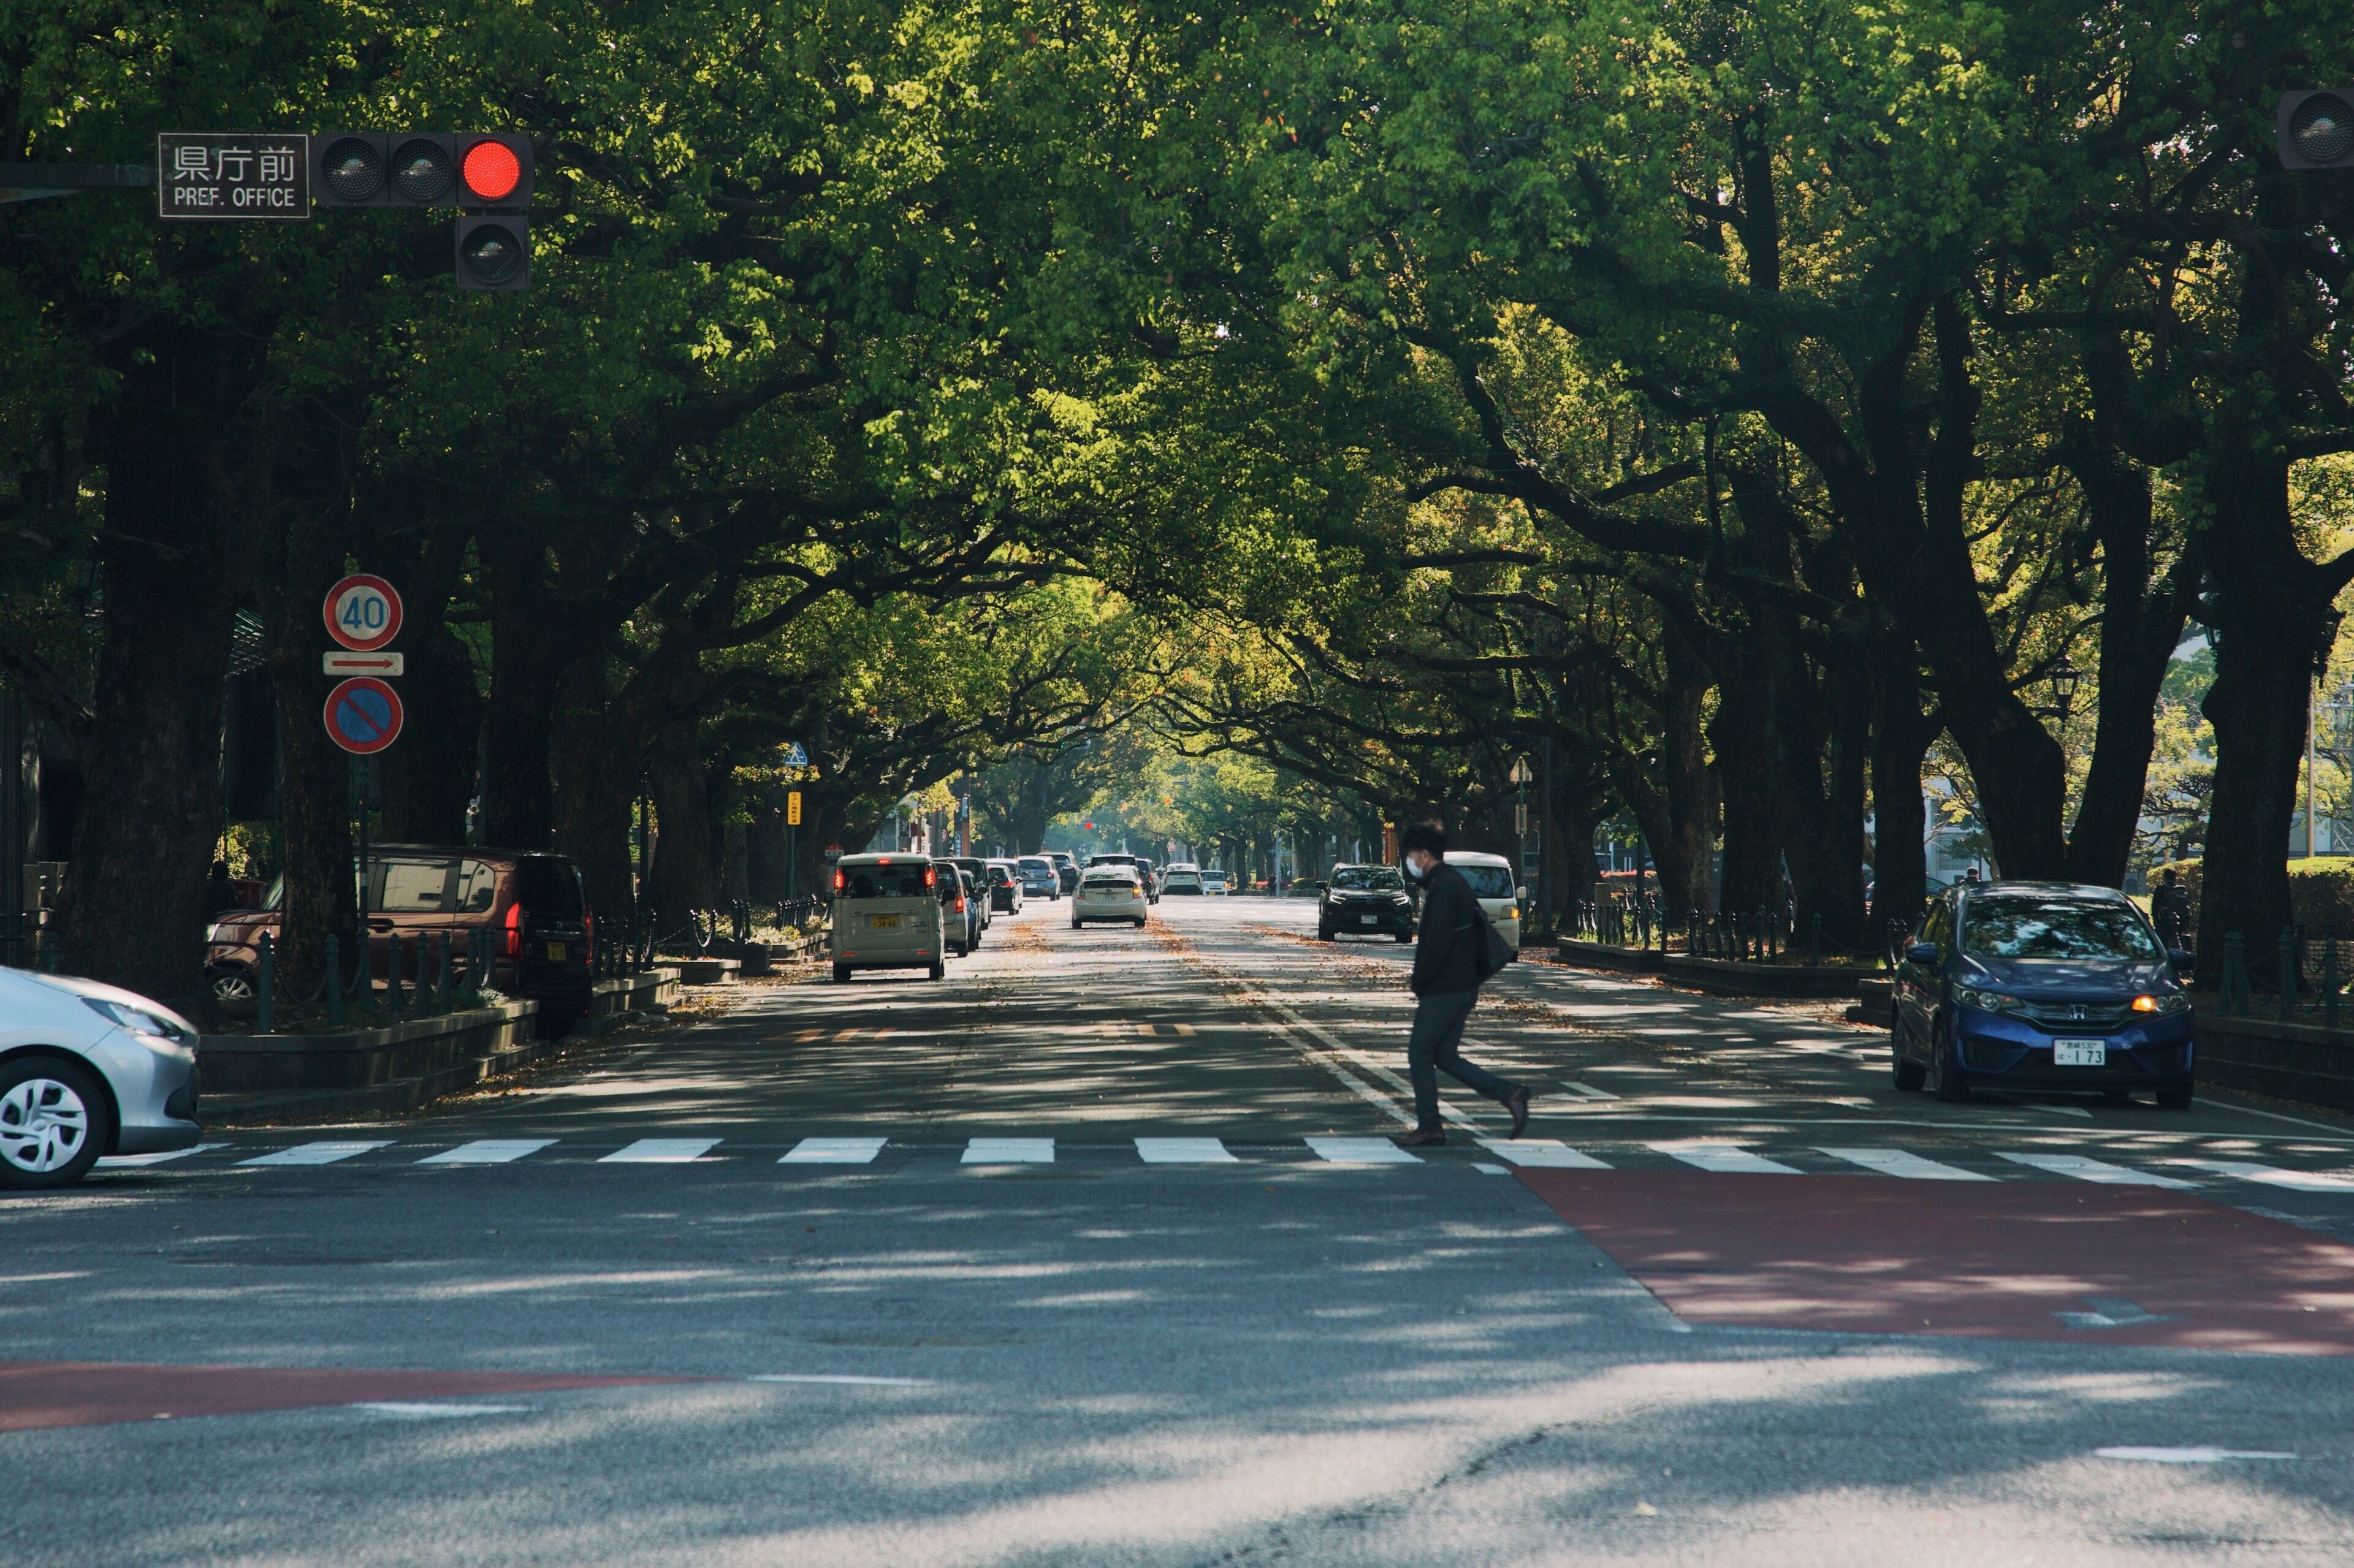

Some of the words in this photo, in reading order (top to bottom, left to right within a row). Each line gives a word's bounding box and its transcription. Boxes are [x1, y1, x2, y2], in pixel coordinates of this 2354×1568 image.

[173, 145, 295, 182] 県庁前
[174, 188, 224, 207] PREF.
[232, 188, 295, 207] OFFICE
[343, 596, 384, 629] 40
